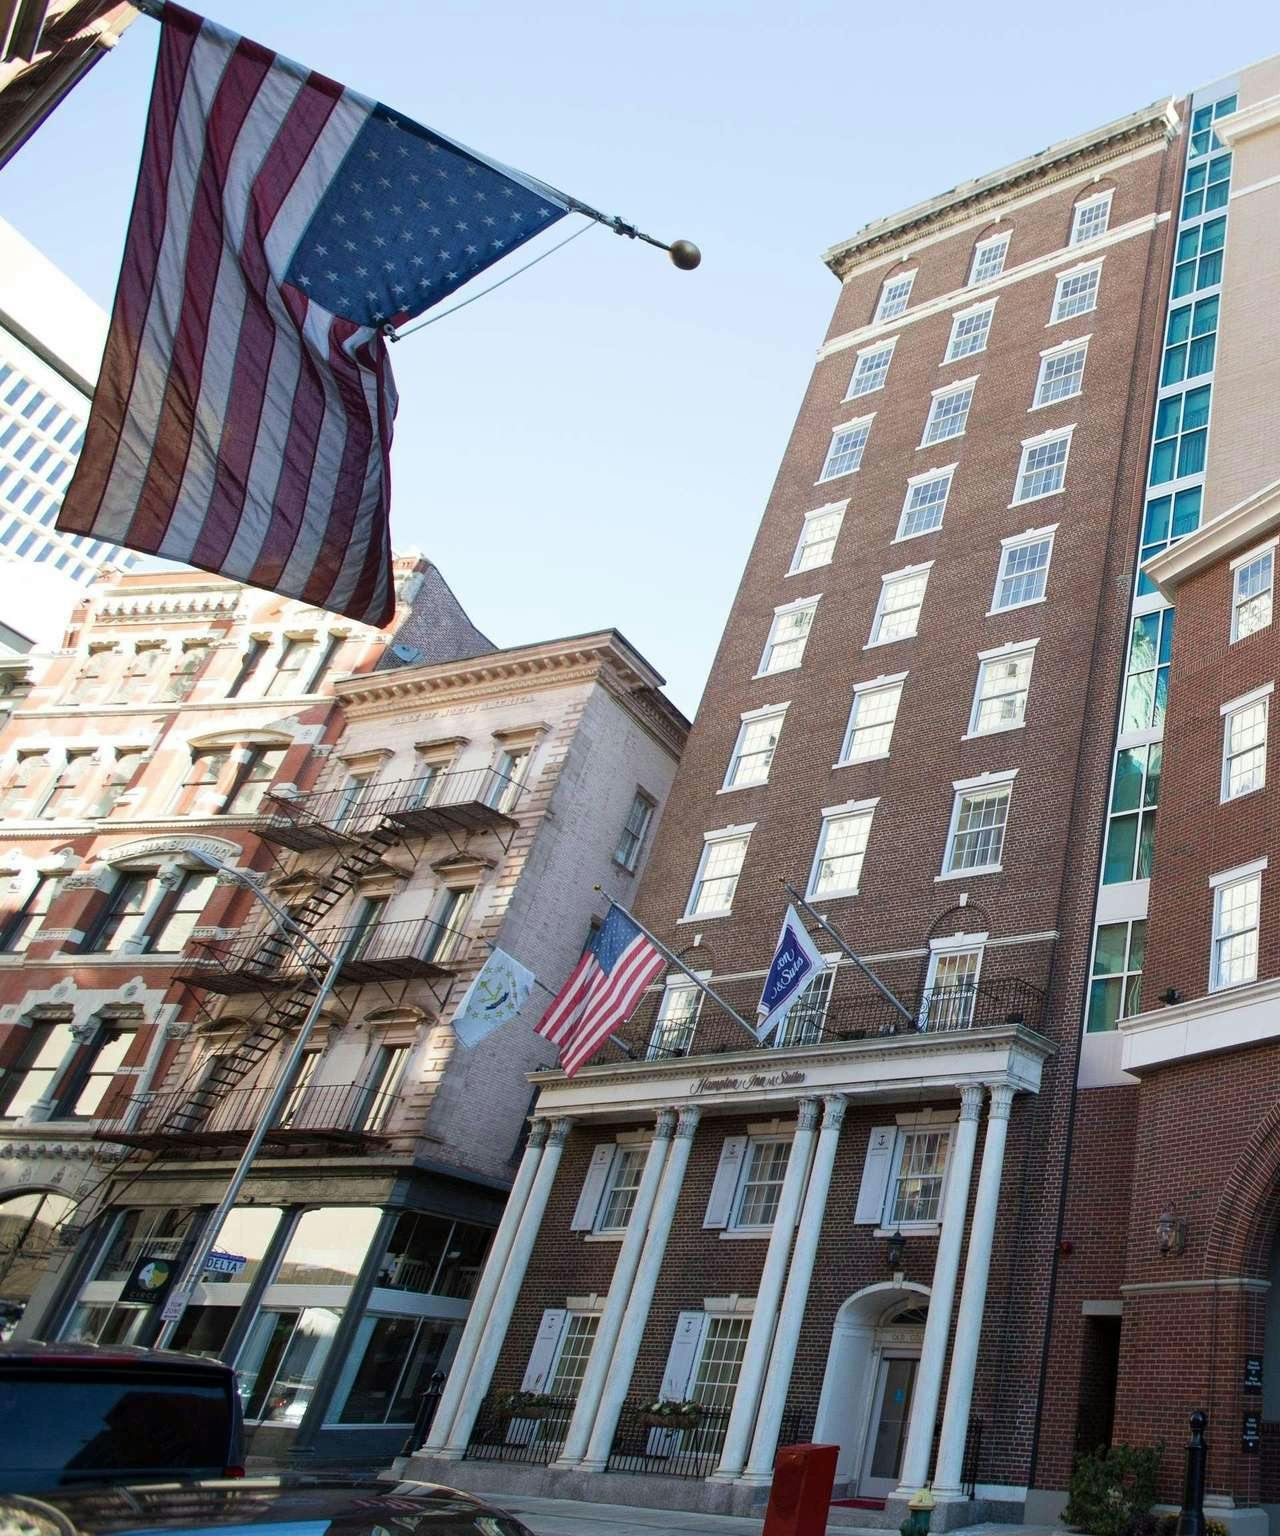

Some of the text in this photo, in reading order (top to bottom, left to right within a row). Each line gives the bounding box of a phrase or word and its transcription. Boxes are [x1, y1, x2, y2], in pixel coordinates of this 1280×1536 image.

[690, 1077, 742, 1095] Hampton
[742, 1074, 766, 1090] Inn
[776, 1070, 806, 1086] Suites
[206, 1257, 238, 1273] DELTA
